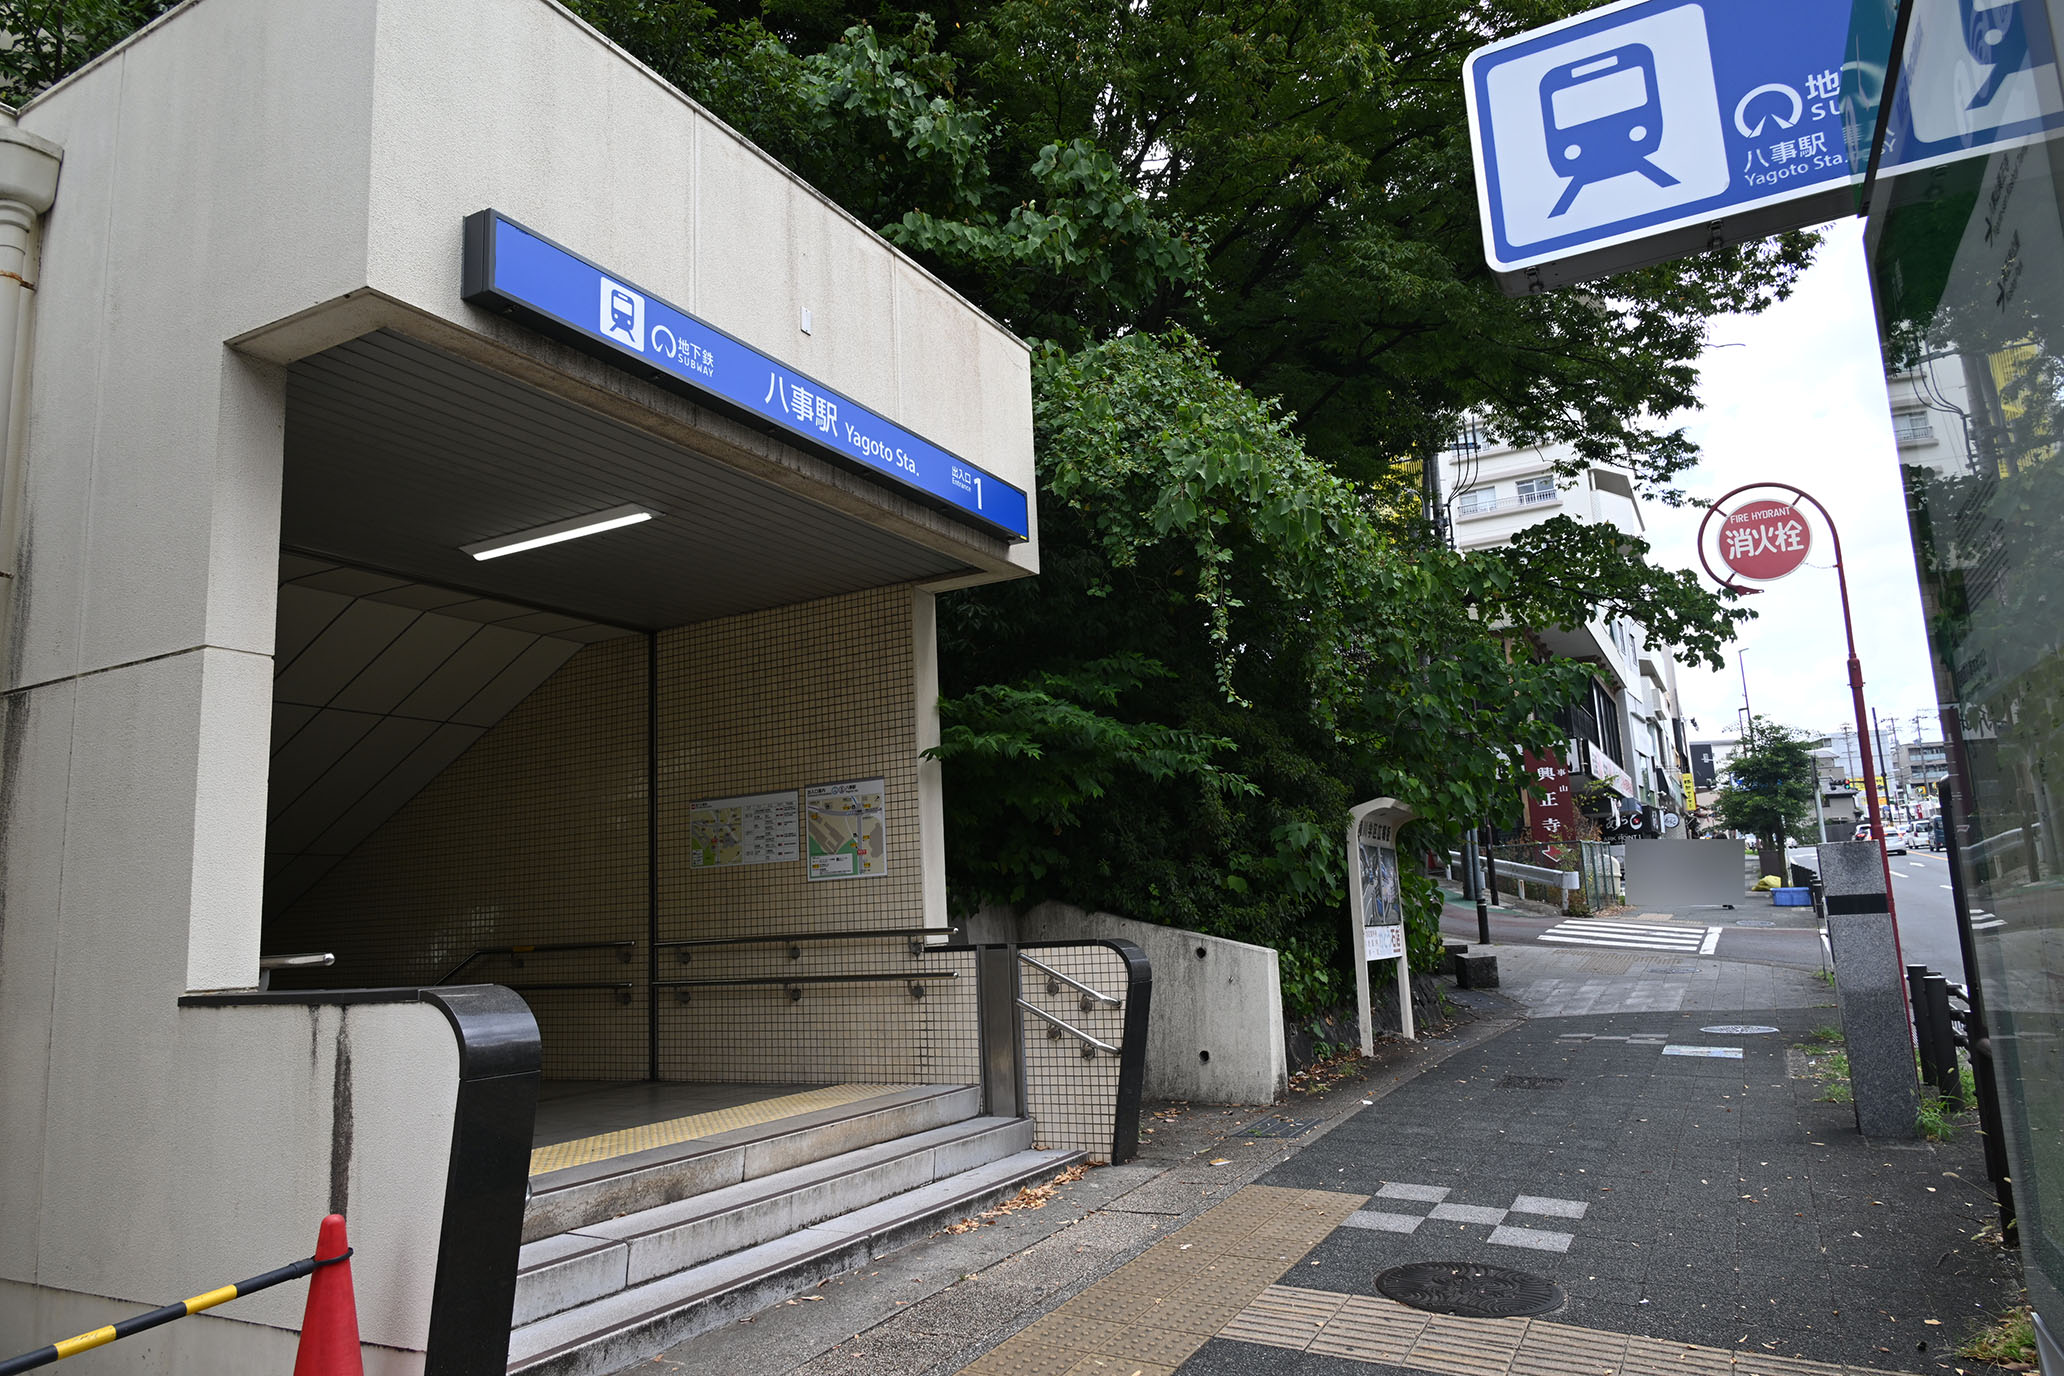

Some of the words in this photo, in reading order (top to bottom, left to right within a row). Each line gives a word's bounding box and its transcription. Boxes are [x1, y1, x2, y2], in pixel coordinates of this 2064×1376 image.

[1744, 132, 1828, 173] 八事駅
[1744, 163, 1809, 187] Yagoto
[1813, 154, 1849, 171] Sta.
[677, 336, 715, 369] 地下鉄
[677, 353, 715, 378] SUBWAY
[764, 371, 839, 439] 八事駅
[845, 421, 894, 465] Yagoto
[895, 448, 920, 478] Sta.
[951, 465, 972, 484] 出入口
[951, 476, 972, 493] Entrance
[973, 477, 984, 511] 1
[1730, 513, 1750, 525] FIRE
[1751, 506, 1791, 521] HYDRANT
[1725, 519, 1805, 560] 消火栓
[1536, 766, 1561, 833] 興正寺
